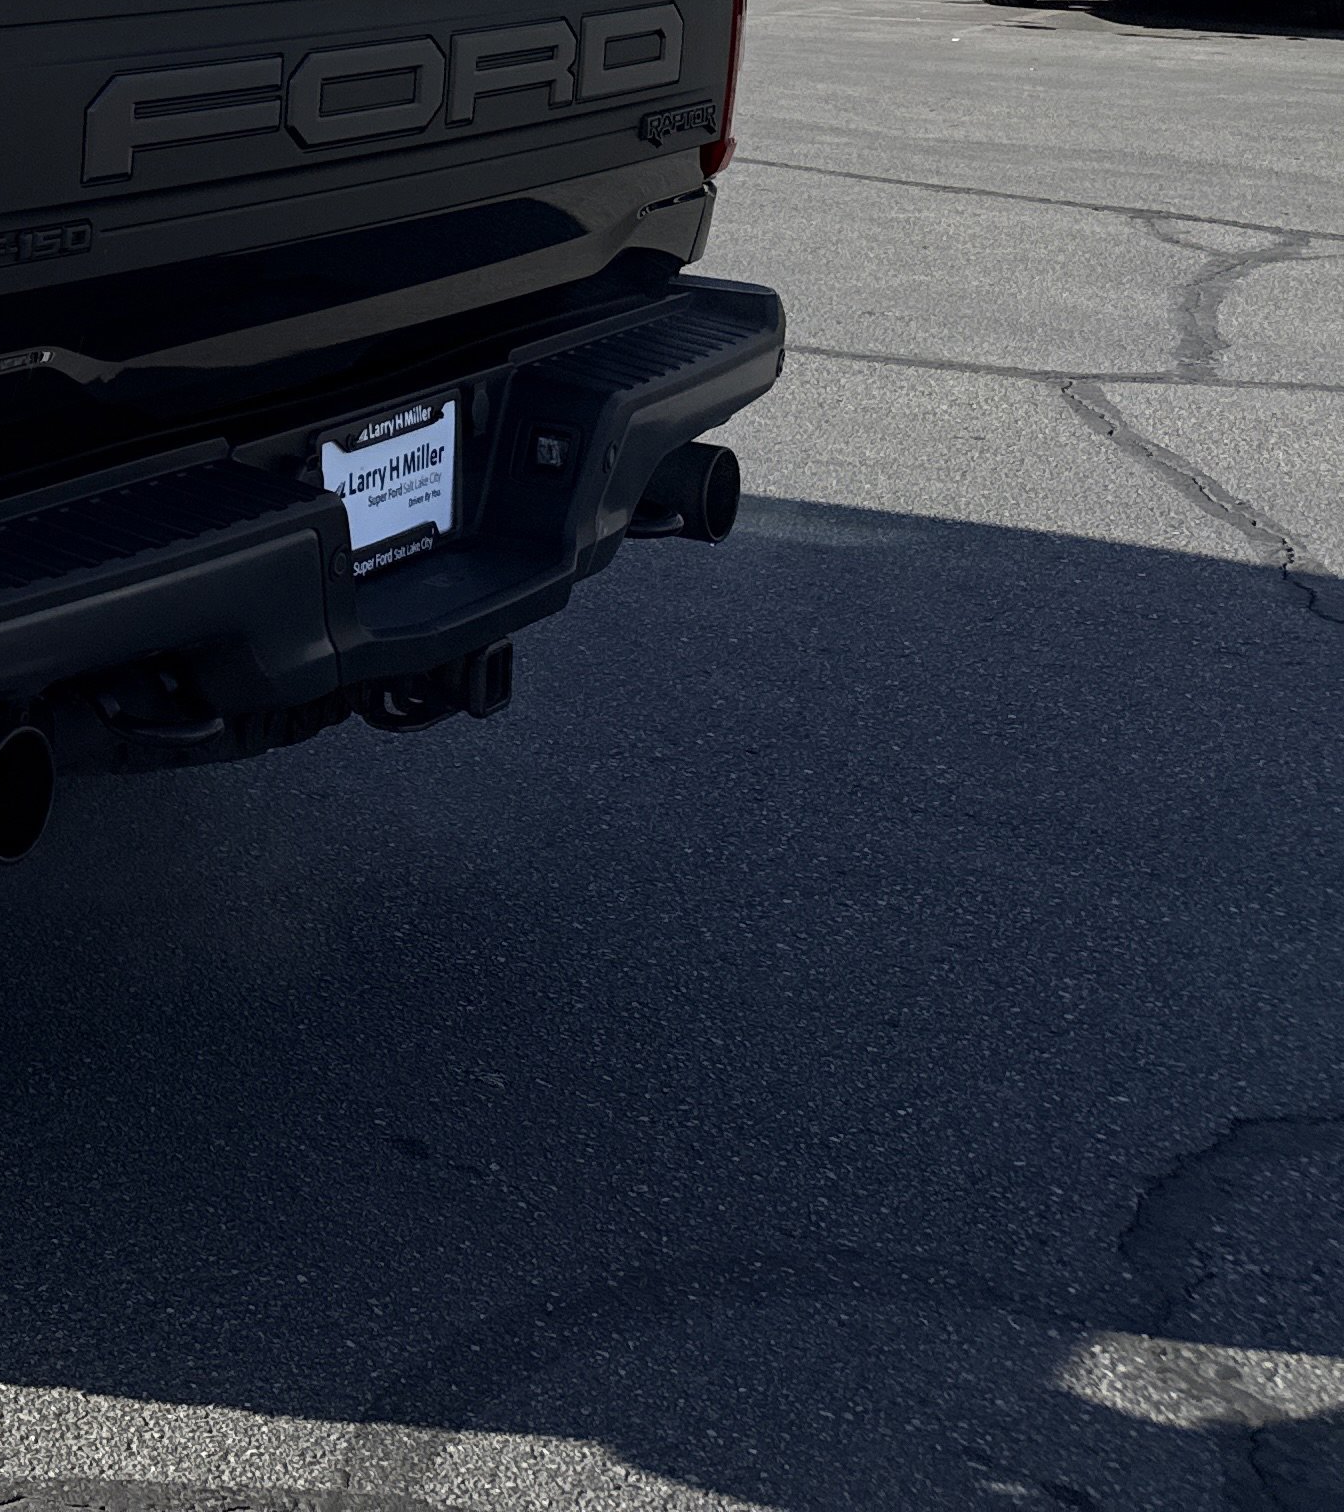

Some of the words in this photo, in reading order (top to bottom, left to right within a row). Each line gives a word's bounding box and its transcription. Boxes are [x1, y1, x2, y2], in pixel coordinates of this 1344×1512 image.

[80, 0, 686, 187] FORD
[646, 103, 717, 144] RAPTOR
[368, 418, 395, 439] Larry
[395, 414, 403, 431] H
[404, 404, 432, 427] Miller
[349, 464, 387, 496] Larry
[389, 455, 400, 482] H
[402, 442, 445, 477] Miller
[368, 491, 388, 507] Super
[388, 483, 403, 500] Ford
[403, 480, 415, 494] Salt
[415, 475, 429, 490] Lake
[429, 471, 442, 486] City
[408, 495, 424, 508] Driven
[352, 558, 375, 577] Super
[375, 548, 393, 568] Ford
[393, 546, 407, 561] Salt
[406, 541, 421, 556] Lake
[420, 536, 434, 550] City
